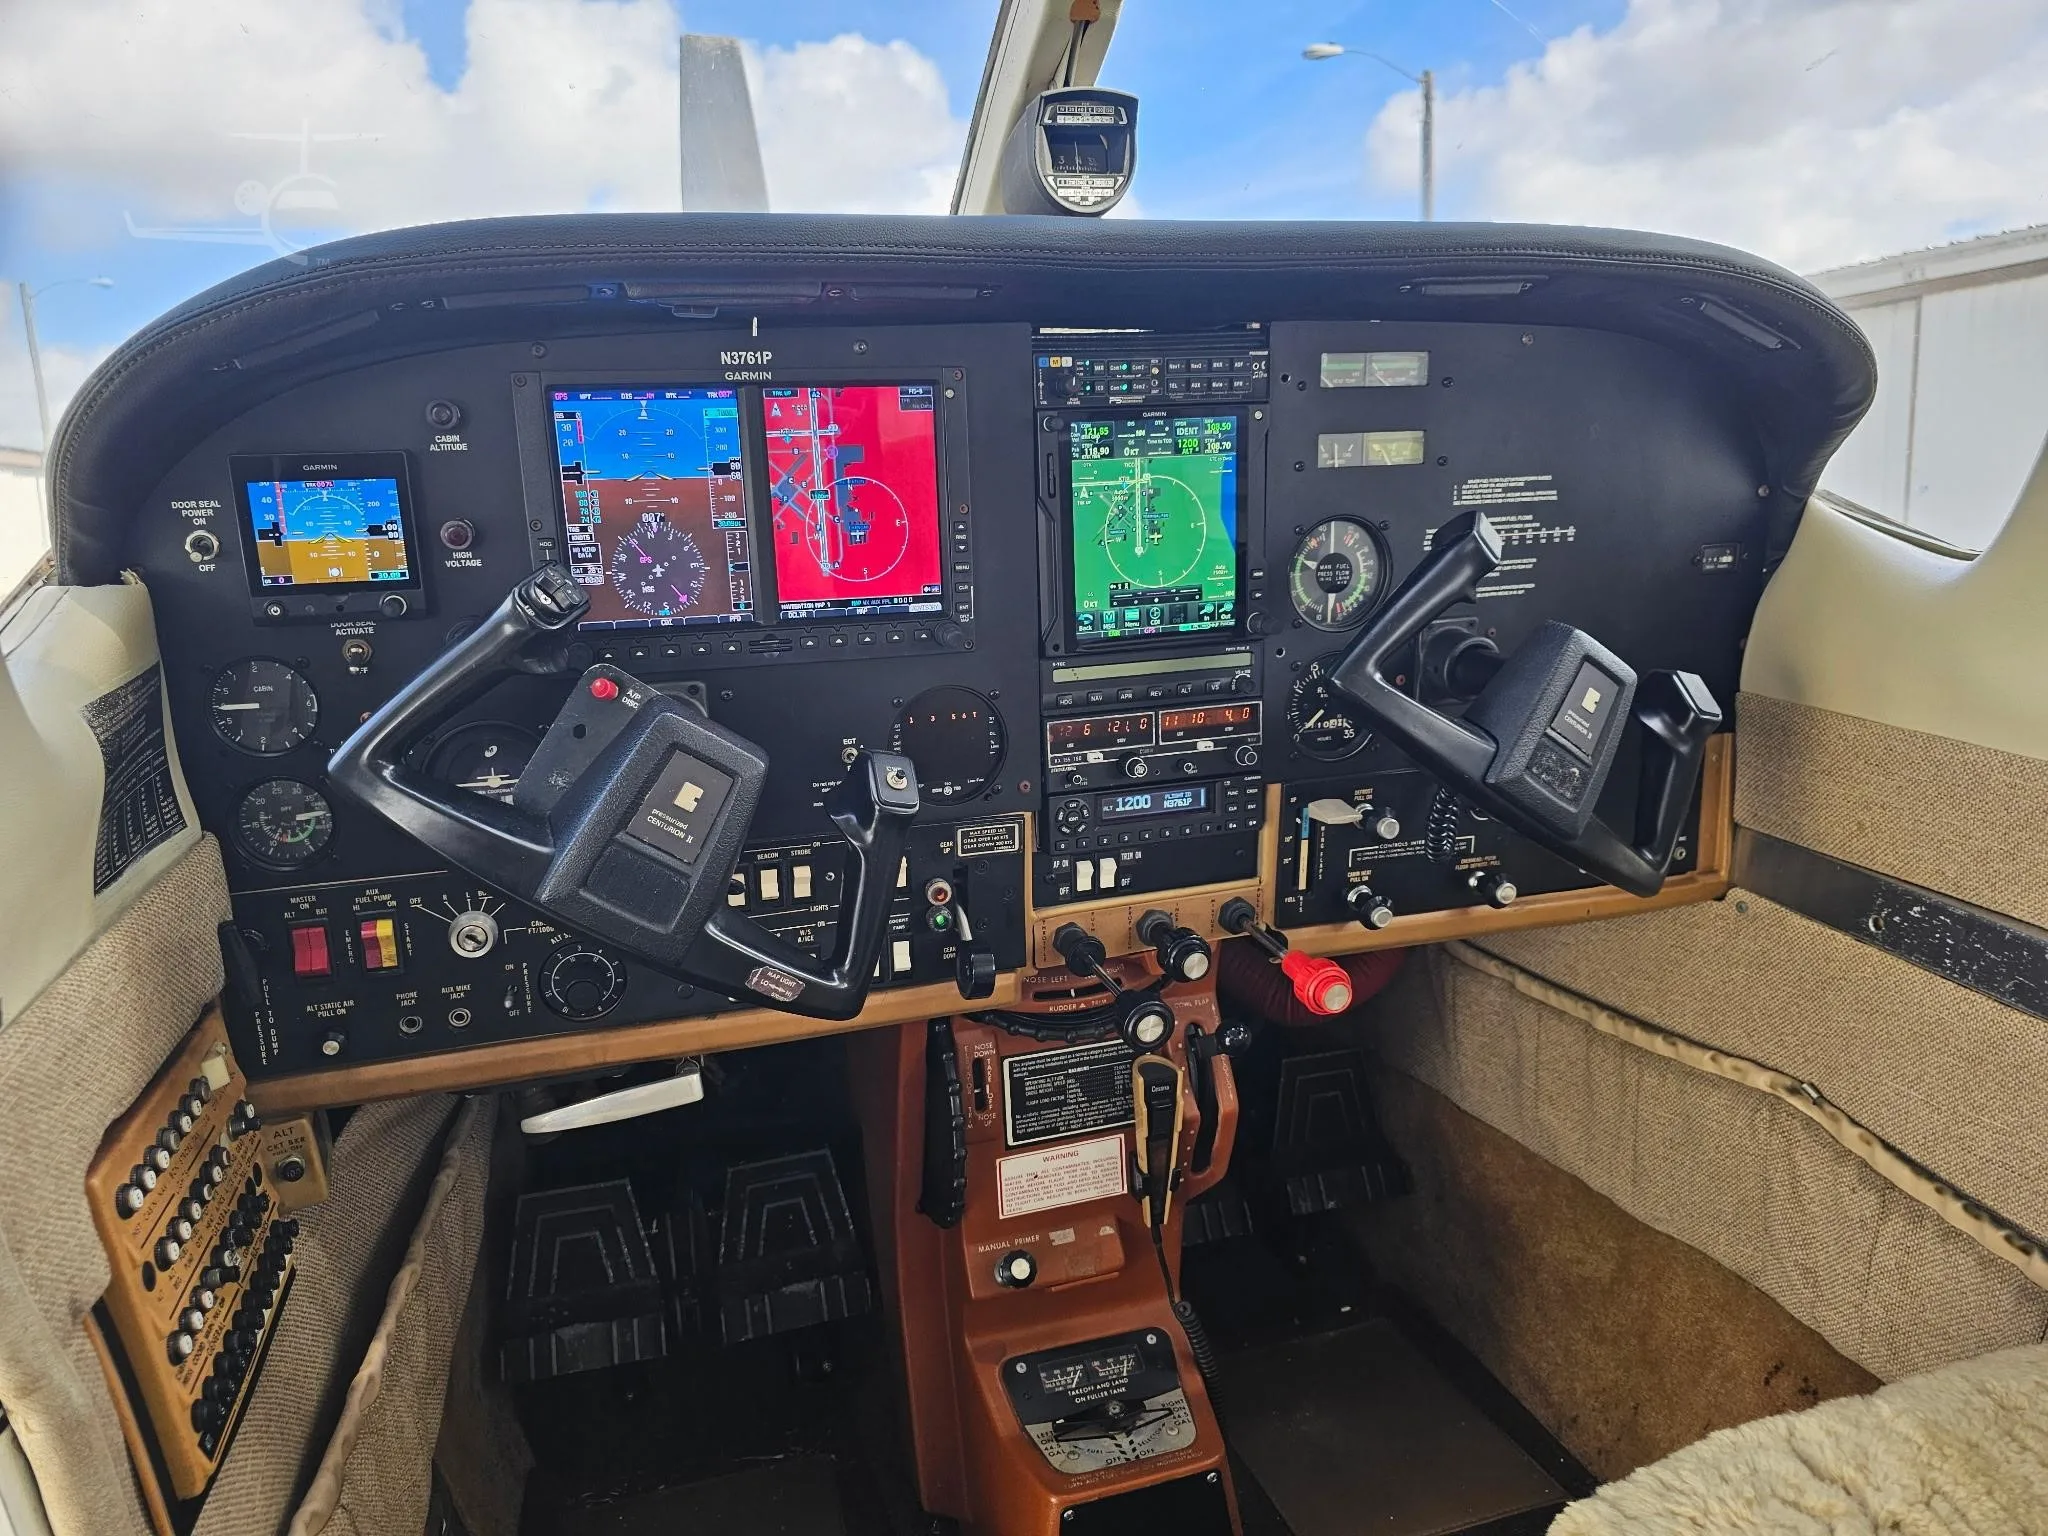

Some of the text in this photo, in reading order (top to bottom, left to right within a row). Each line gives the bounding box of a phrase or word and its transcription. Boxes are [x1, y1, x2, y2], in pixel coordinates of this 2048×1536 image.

[720, 351, 772, 365] N3761P
[725, 371, 772, 380] GARMIN
[1083, 427, 1109, 436] 121.85
[1177, 427, 1199, 435] IDENT
[1207, 423, 1231, 431] 108.50
[429, 443, 468, 451] ALTITUDE
[1178, 439, 1198, 447] 1200
[1207, 442, 1231, 450] 108.70
[1084, 447, 1109, 455] 118.90
[182, 509, 213, 517] POWER
[199, 564, 216, 572] OFF
[445, 559, 482, 568] VOLTAGE
[335, 627, 375, 635] ACTIVATE
[627, 690, 641, 700] A/P
[622, 697, 639, 709] DISC
[1343, 729, 1355, 738] 35
[1116, 795, 1151, 811] 1200
[1164, 798, 1193, 808] N3761P
[652, 809, 688, 830] pressurized
[647, 815, 685, 839] CENTURION
[757, 852, 779, 860] BEACON
[1121, 852, 1133, 860] TRIM
[1121, 878, 1131, 886] OFF
[1060, 887, 1069, 895] OFF
[290, 896, 316, 904] MASTER
[409, 897, 422, 905] OFF
[810, 904, 829, 912] LIGHTS
[345, 930, 354, 964] EMERG
[943, 946, 956, 954] GEAR
[767, 970, 796, 987] MAP LIGHT
[1024, 975, 1068, 984] NOSE LEFT
[441, 984, 471, 994] AUX MIKE
[522, 963, 531, 1013] PRESSURE
[396, 992, 418, 1000] PHONE
[320, 1002, 342, 1010] STATIC
[400, 999, 416, 1007] JACK
[1049, 1004, 1077, 1012] RUDDER
[269, 1011, 274, 1023] TO
[255, 1012, 267, 1065] PRESSURE
[975, 1042, 993, 1051] NOSE
[974, 1049, 995, 1057] DOWN
[1152, 1085, 1170, 1093] Cessna
[273, 1127, 295, 1139] ALT
[267, 1137, 306, 1152] CKT BKR
[1043, 1150, 1079, 1162] WARNING
[978, 1235, 1040, 1253] MANUAL PRIMER
[1068, 1385, 1094, 1396] TAKEOFF
[1112, 1378, 1128, 1386] LAND
[1087, 1392, 1108, 1400] FULLER
[1161, 1399, 1185, 1408] RIGHT
[1037, 1431, 1053, 1439] LEFT
[1137, 1427, 1163, 1446] SELECTOR
[1106, 1456, 1122, 1465] OFF
